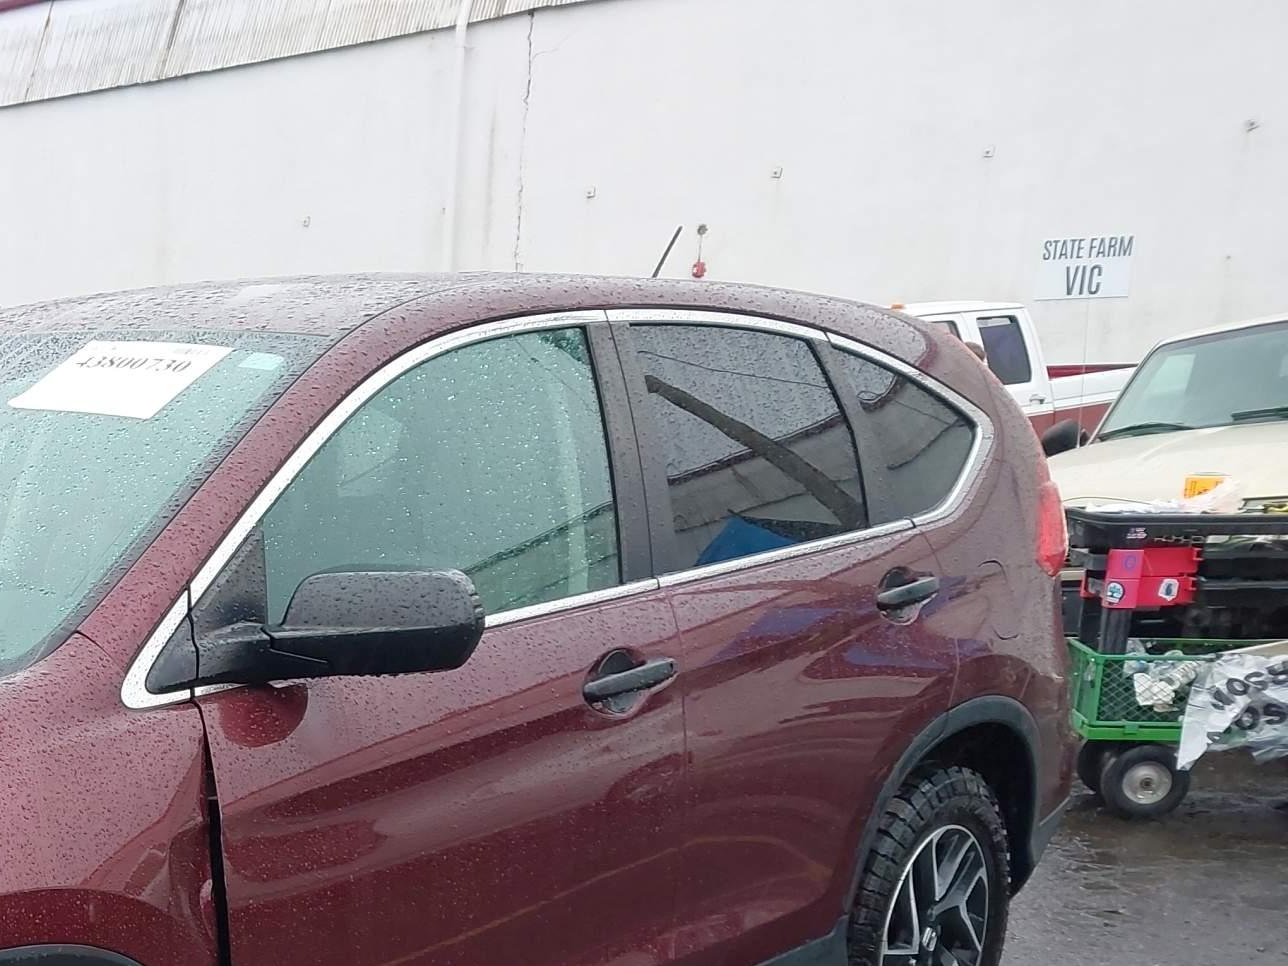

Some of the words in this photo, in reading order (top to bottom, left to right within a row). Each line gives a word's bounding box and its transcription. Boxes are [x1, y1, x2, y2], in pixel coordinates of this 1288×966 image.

[1042, 238, 1086, 261] STATE
[1088, 235, 1135, 259] FARM
[1065, 264, 1103, 296] VIC
[75, 355, 192, 373] 43800730
